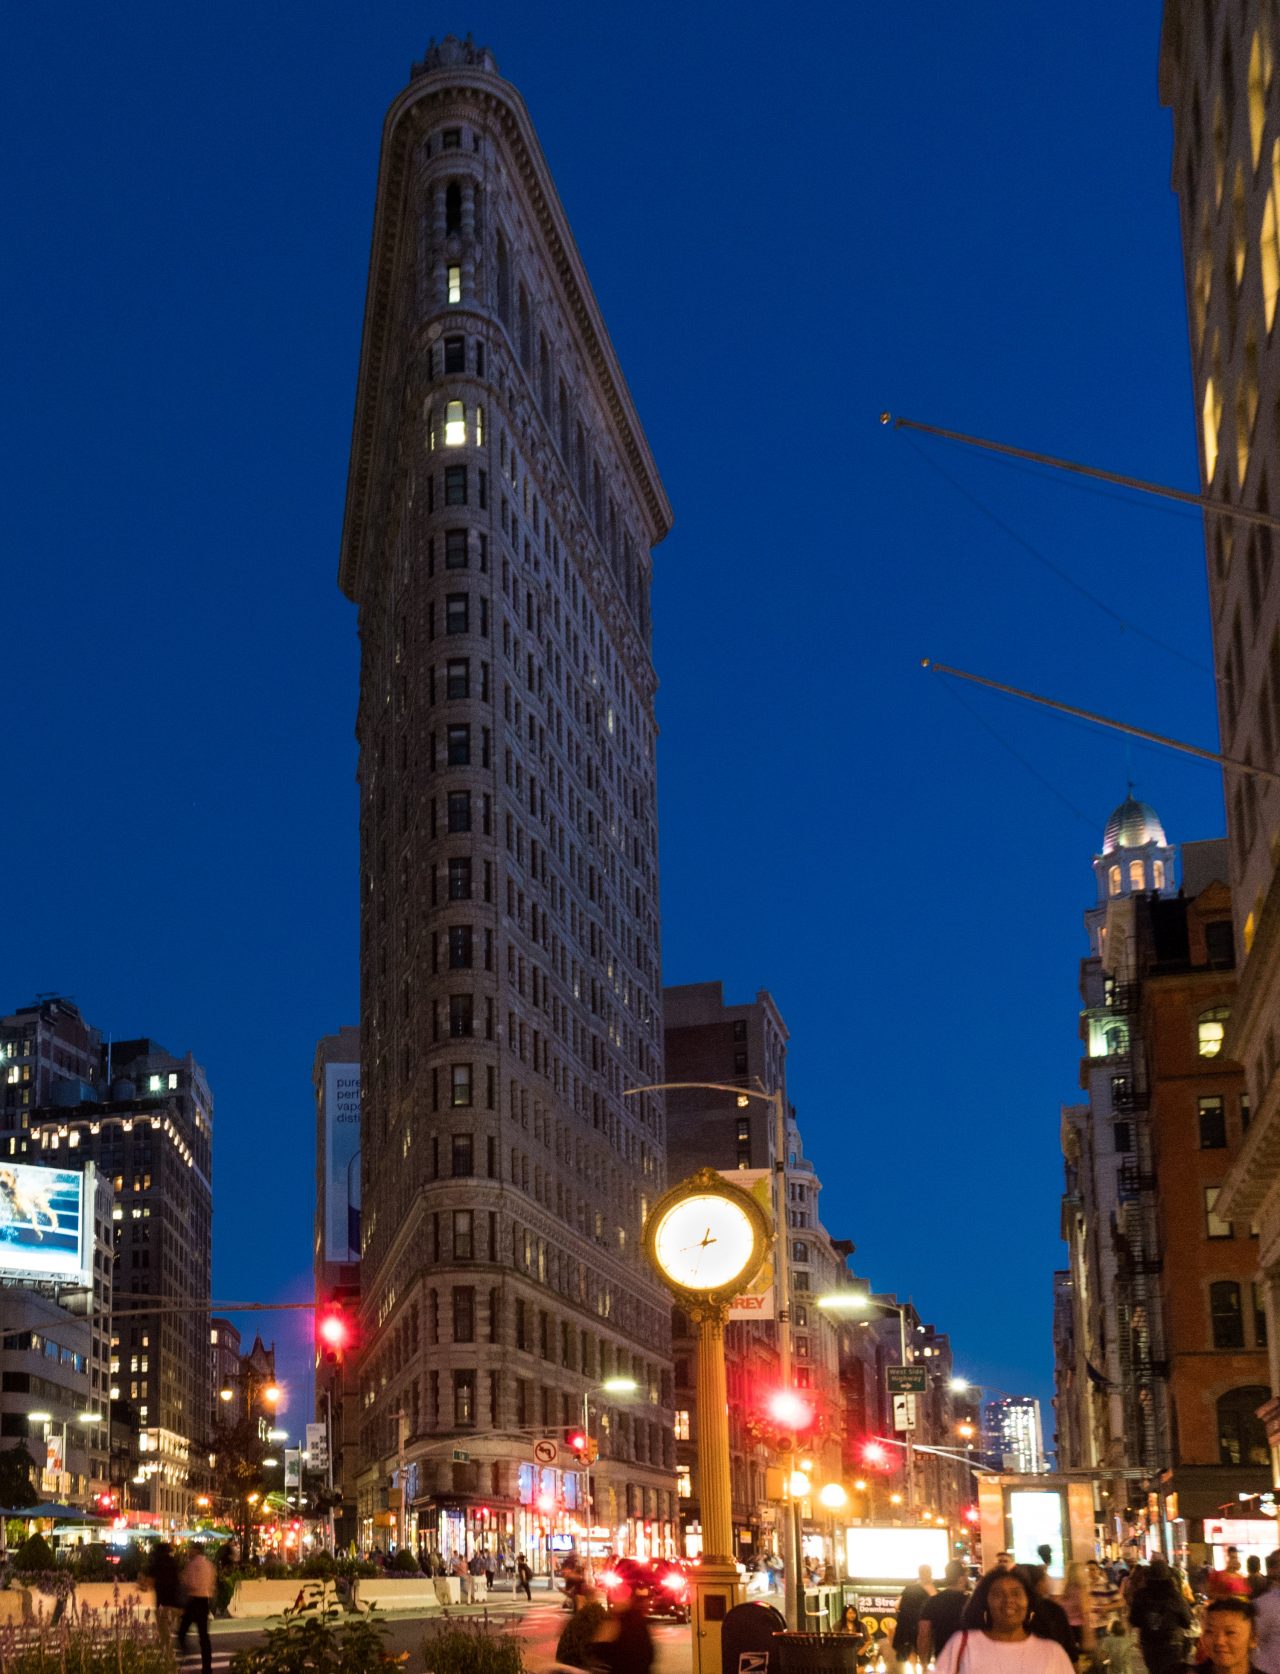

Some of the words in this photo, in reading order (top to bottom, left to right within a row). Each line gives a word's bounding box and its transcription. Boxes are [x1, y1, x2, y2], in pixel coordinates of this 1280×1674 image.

[337, 1079, 361, 1088] pure
[731, 1297, 765, 1309] REY
[859, 1597, 872, 1606] 23
[875, 1597, 894, 1606] Stre
